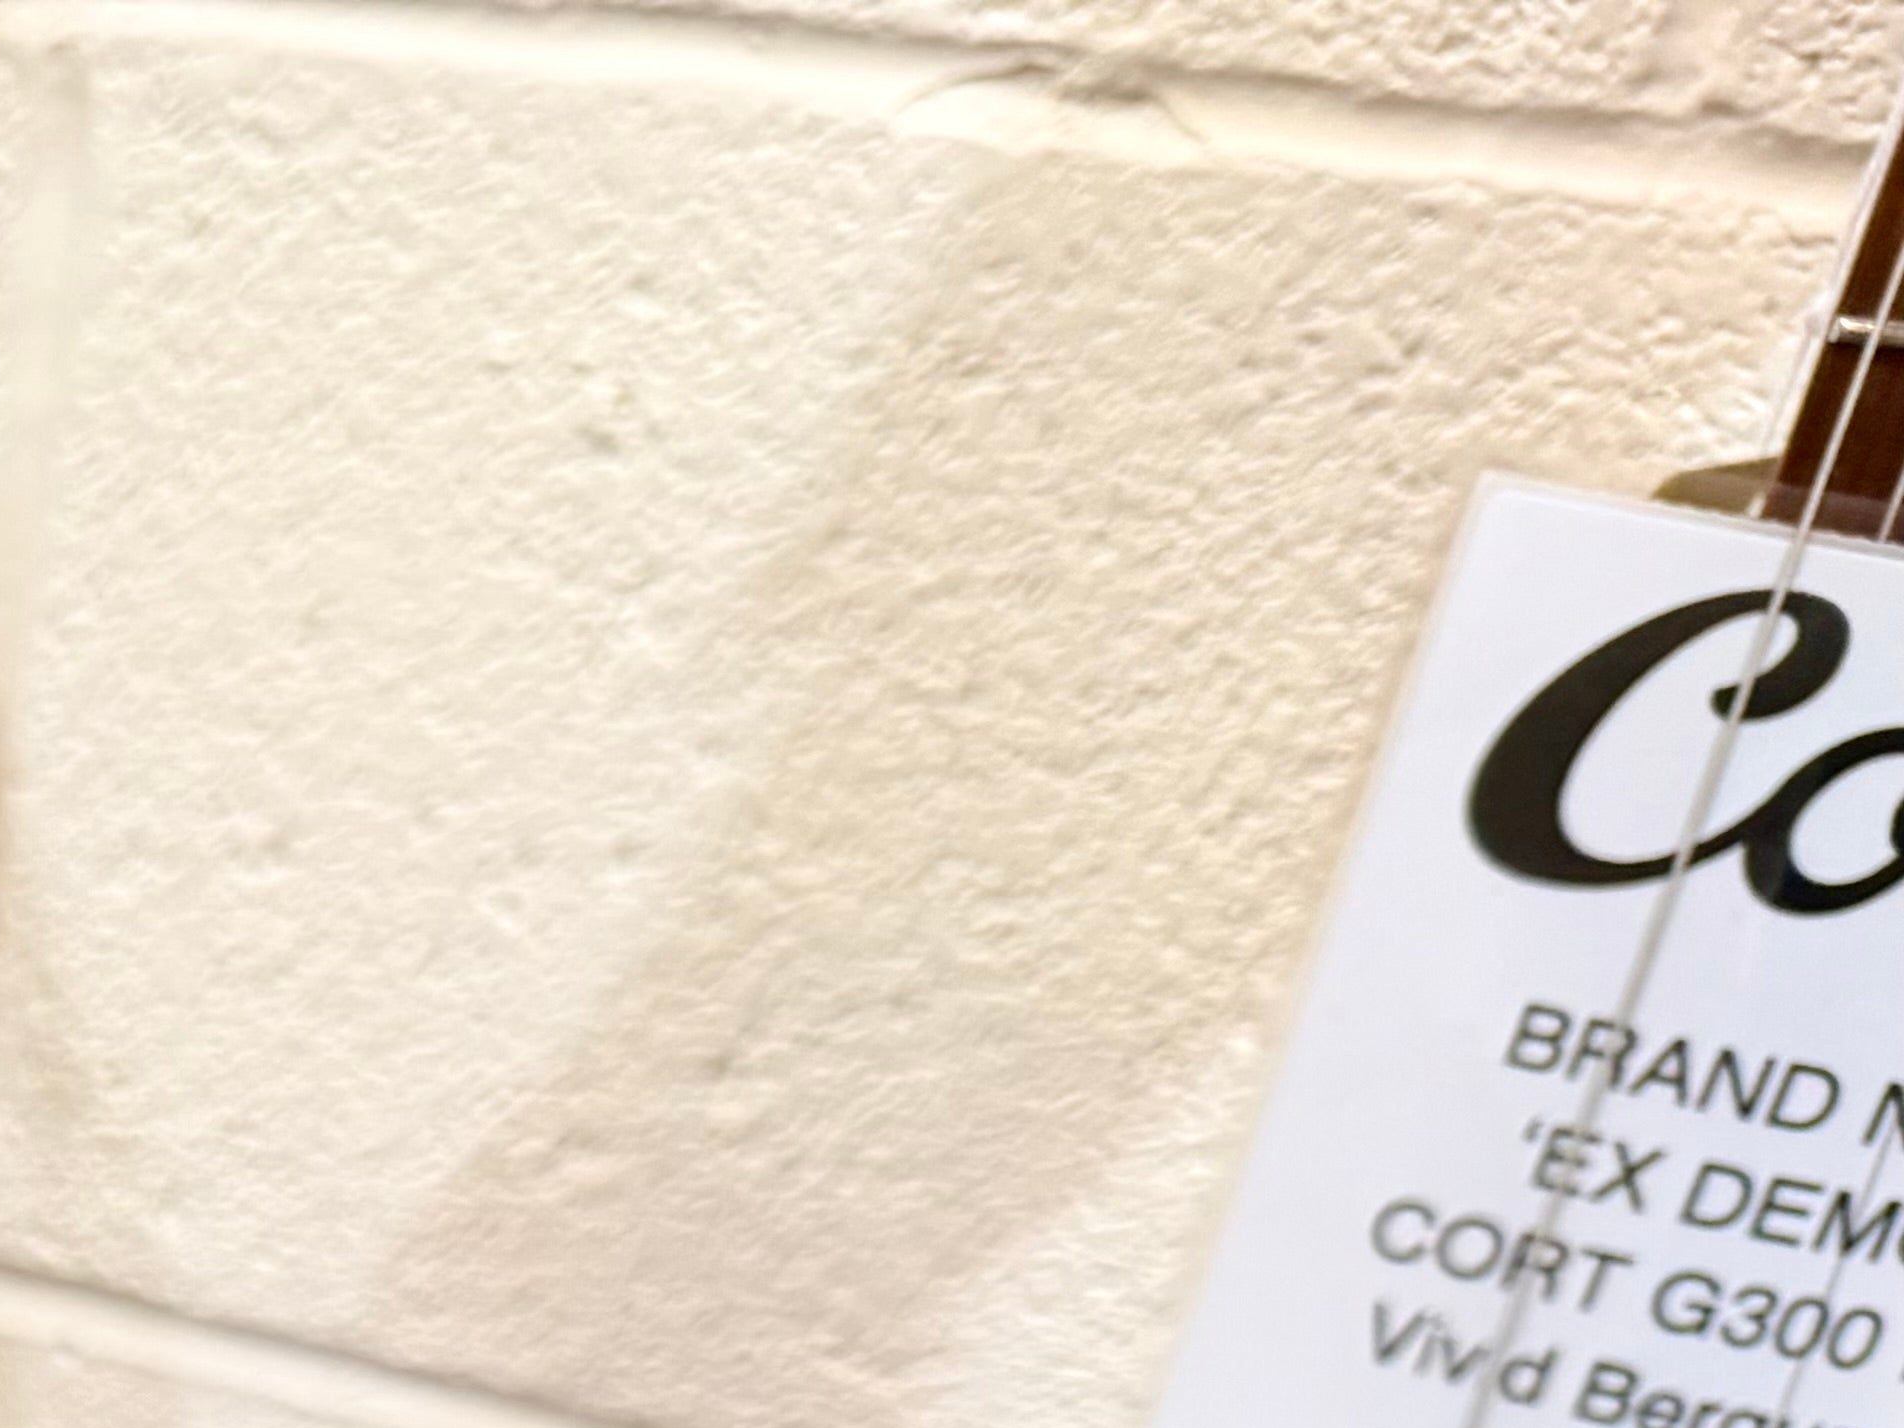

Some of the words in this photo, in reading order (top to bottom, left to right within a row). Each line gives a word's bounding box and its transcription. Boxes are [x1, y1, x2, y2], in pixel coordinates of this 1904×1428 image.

[1502, 1001, 1841, 1132] BRAND
[1678, 1159, 1904, 1267] DEM
[1369, 1199, 1636, 1313] CORT
[1650, 1269, 1885, 1372] G300
[1370, 1298, 1559, 1407] Vivd
